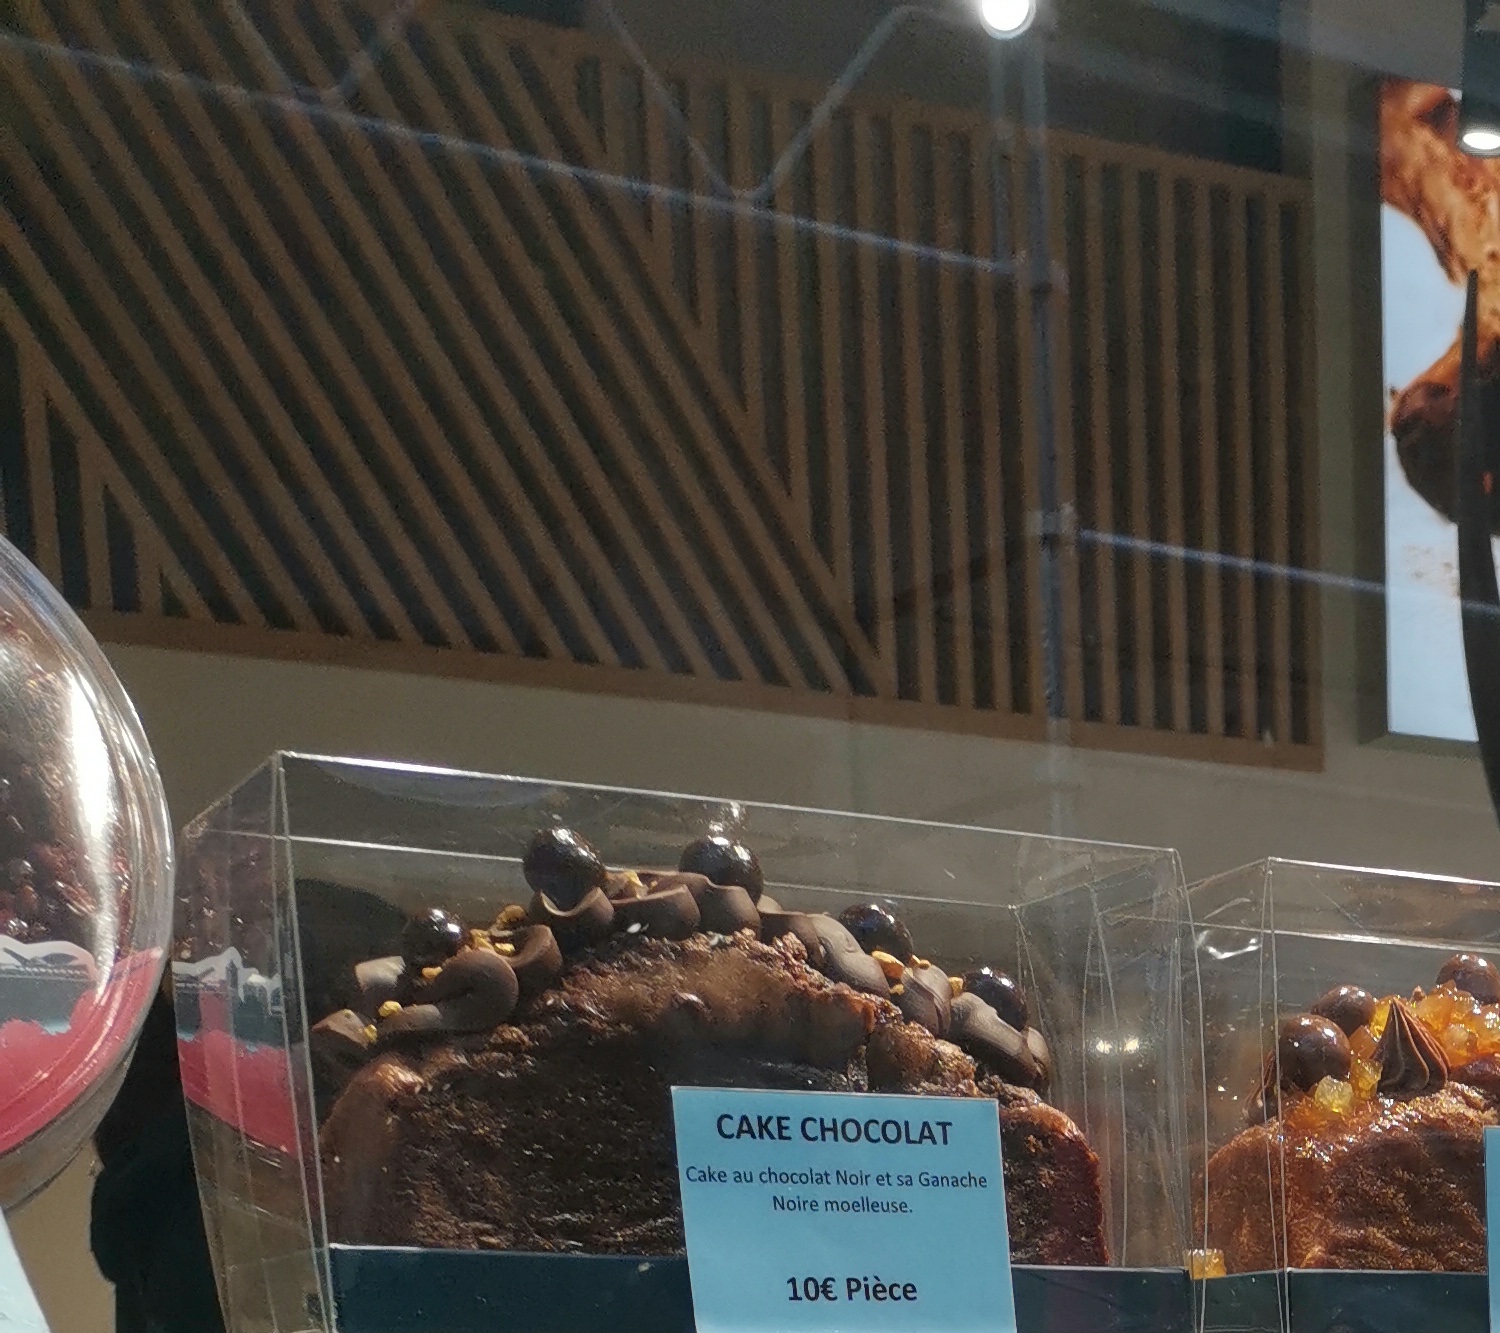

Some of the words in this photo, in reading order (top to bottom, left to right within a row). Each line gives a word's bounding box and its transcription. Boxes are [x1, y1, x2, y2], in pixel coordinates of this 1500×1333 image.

[716, 1113, 791, 1141] CAKE
[800, 1116, 953, 1146] CHOCOLAT
[685, 1166, 728, 1184] Cake
[733, 1171, 754, 1185] au
[758, 1168, 832, 1187] chocolat
[836, 1169, 872, 1187] Noir
[875, 1173, 893, 1187] et
[897, 1174, 914, 1188] sa
[918, 1171, 988, 1189] Ganache
[773, 1195, 819, 1213] Noire
[824, 1195, 914, 1214] moelleuse.
[786, 1276, 838, 1302] 10€
[846, 1275, 918, 1302] Pièce
